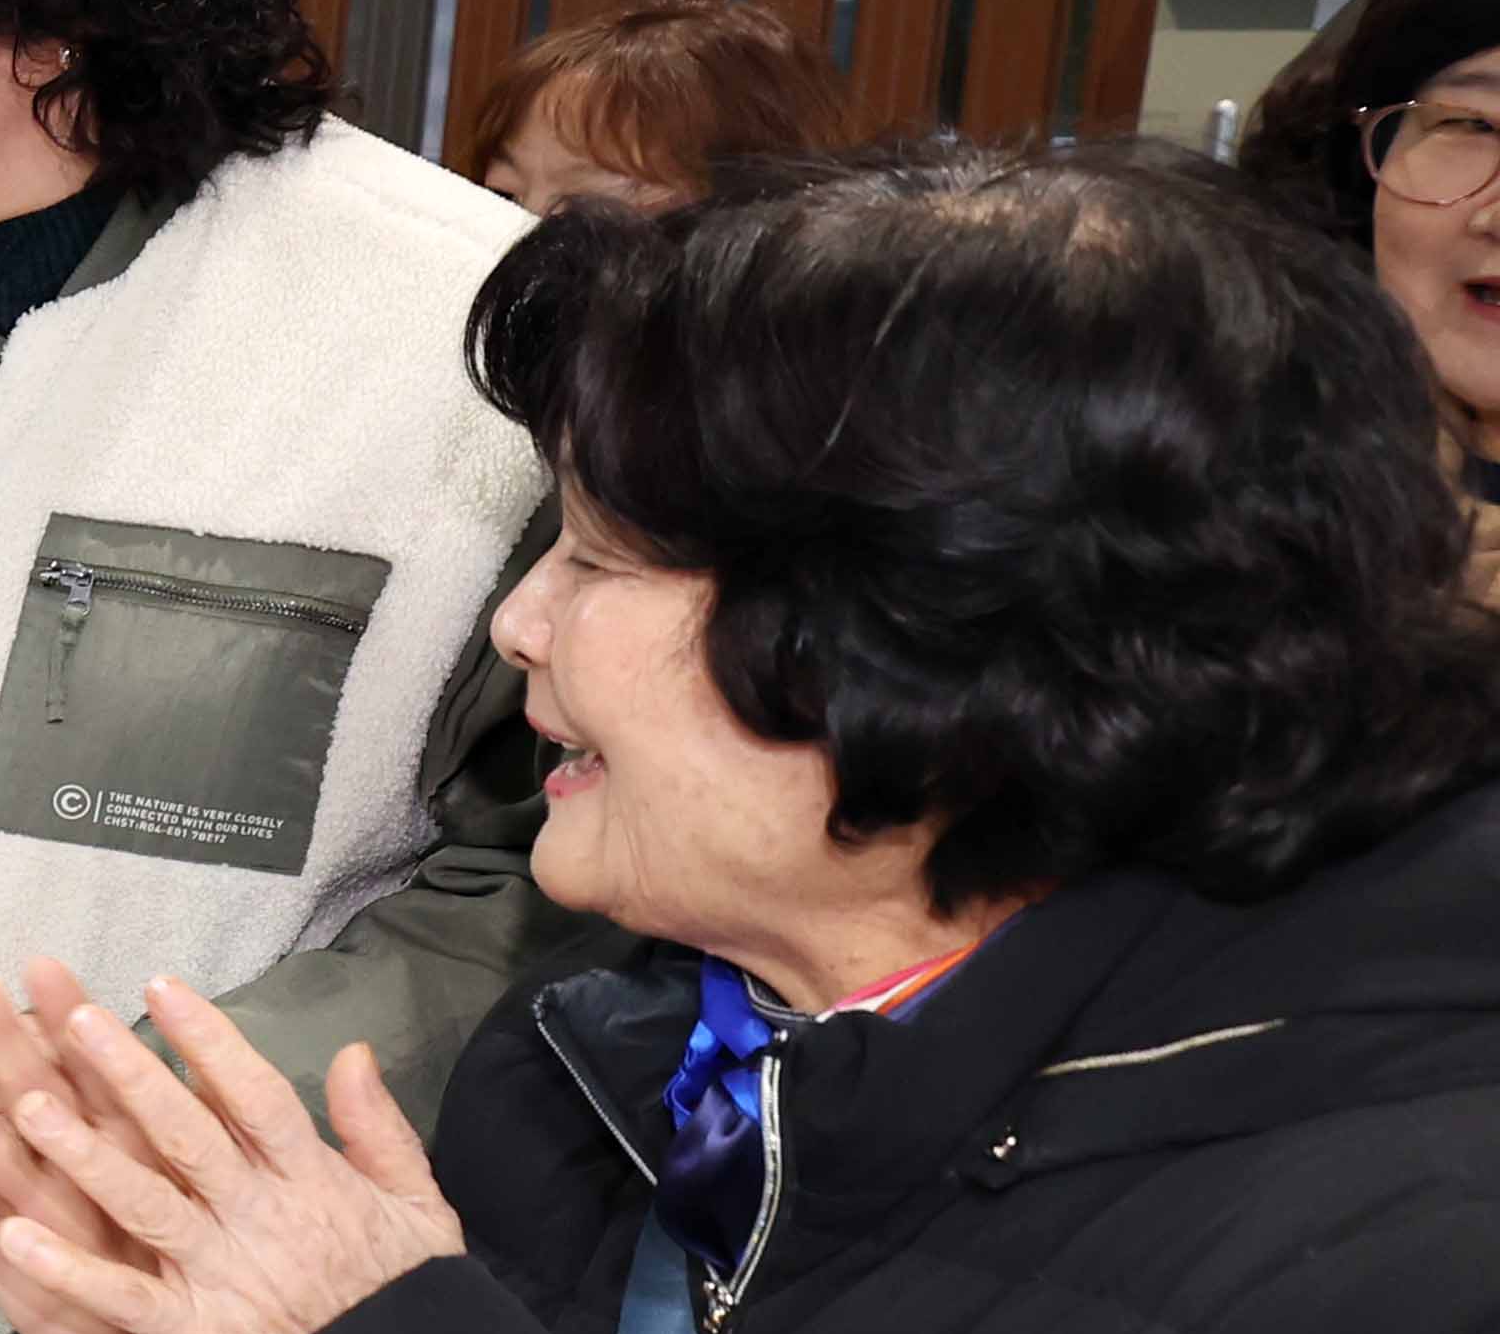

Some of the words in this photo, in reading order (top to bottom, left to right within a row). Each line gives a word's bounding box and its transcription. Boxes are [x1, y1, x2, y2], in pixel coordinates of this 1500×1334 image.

[106, 804, 179, 825] CONNECTED
[182, 817, 213, 831] WITH
[215, 822, 238, 835] OUR
[241, 825, 274, 840] LIVES
[108, 792, 132, 805] THE
[135, 794, 184, 814] NATURE
[187, 806, 199, 817] IS
[203, 809, 232, 822] VERY
[234, 813, 285, 830] CLOSELY
